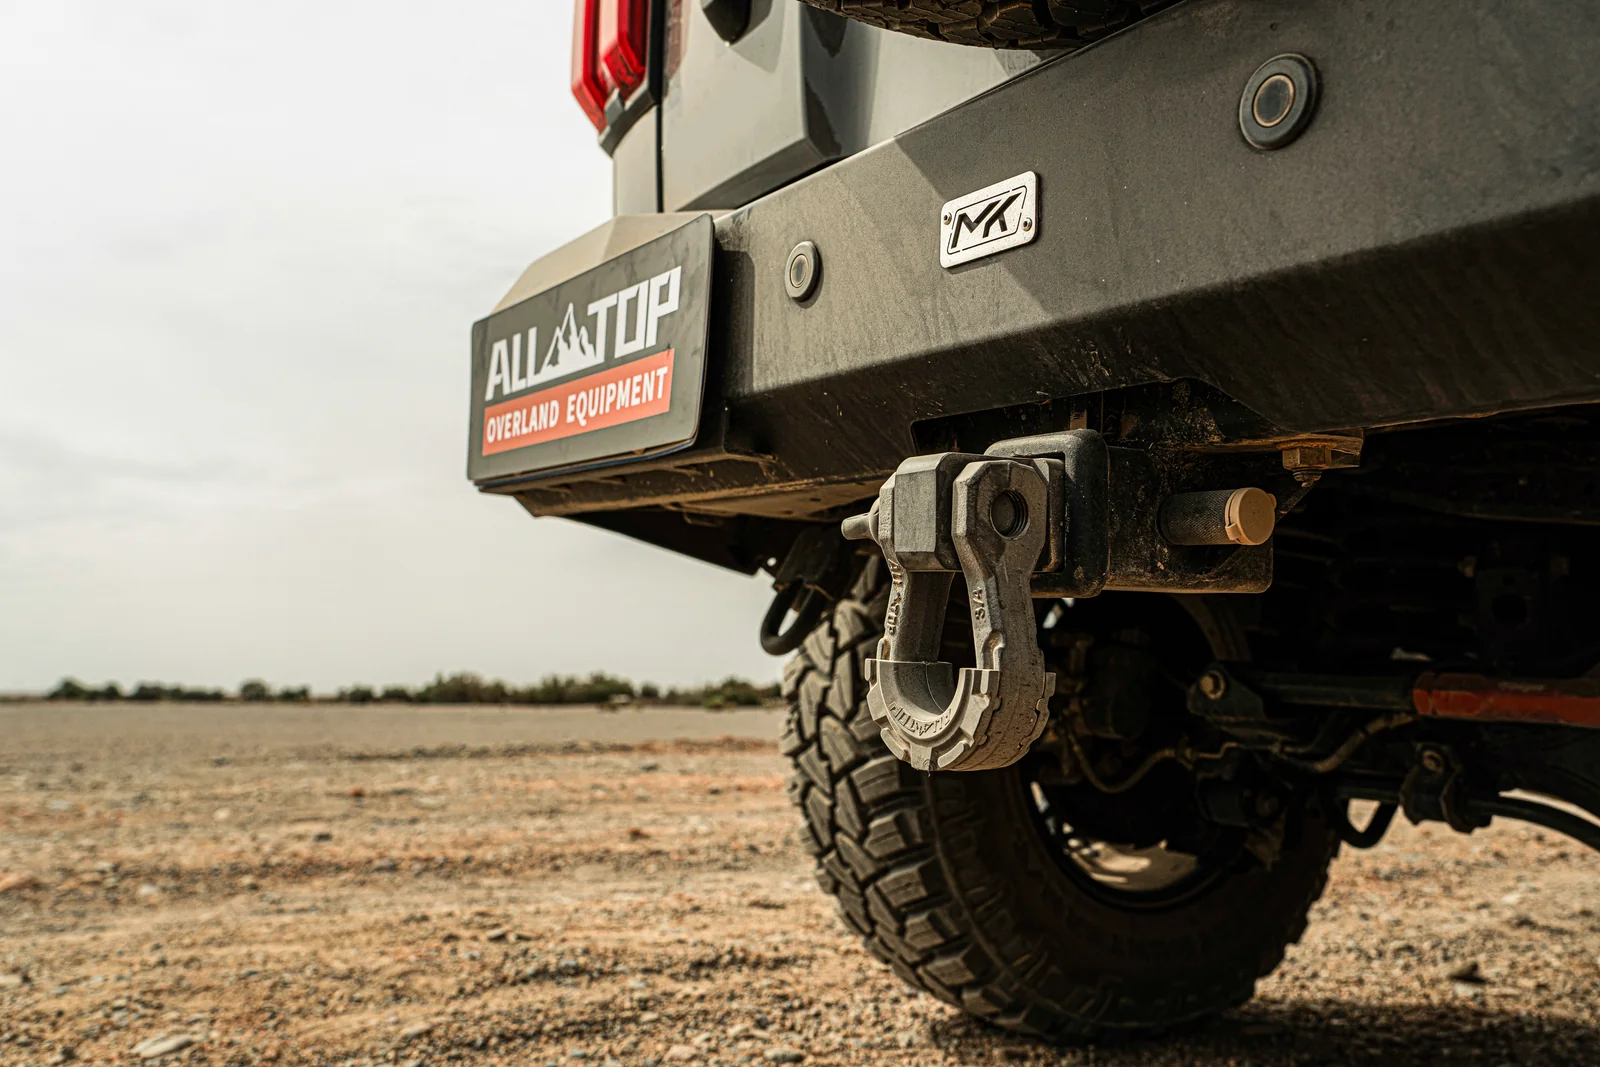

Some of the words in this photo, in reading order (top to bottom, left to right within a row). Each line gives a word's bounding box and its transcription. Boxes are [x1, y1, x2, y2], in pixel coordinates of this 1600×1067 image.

[951, 192, 1022, 249] MK
[487, 400, 560, 443] OVERLAND
[566, 366, 669, 426] EQUIPMENT
